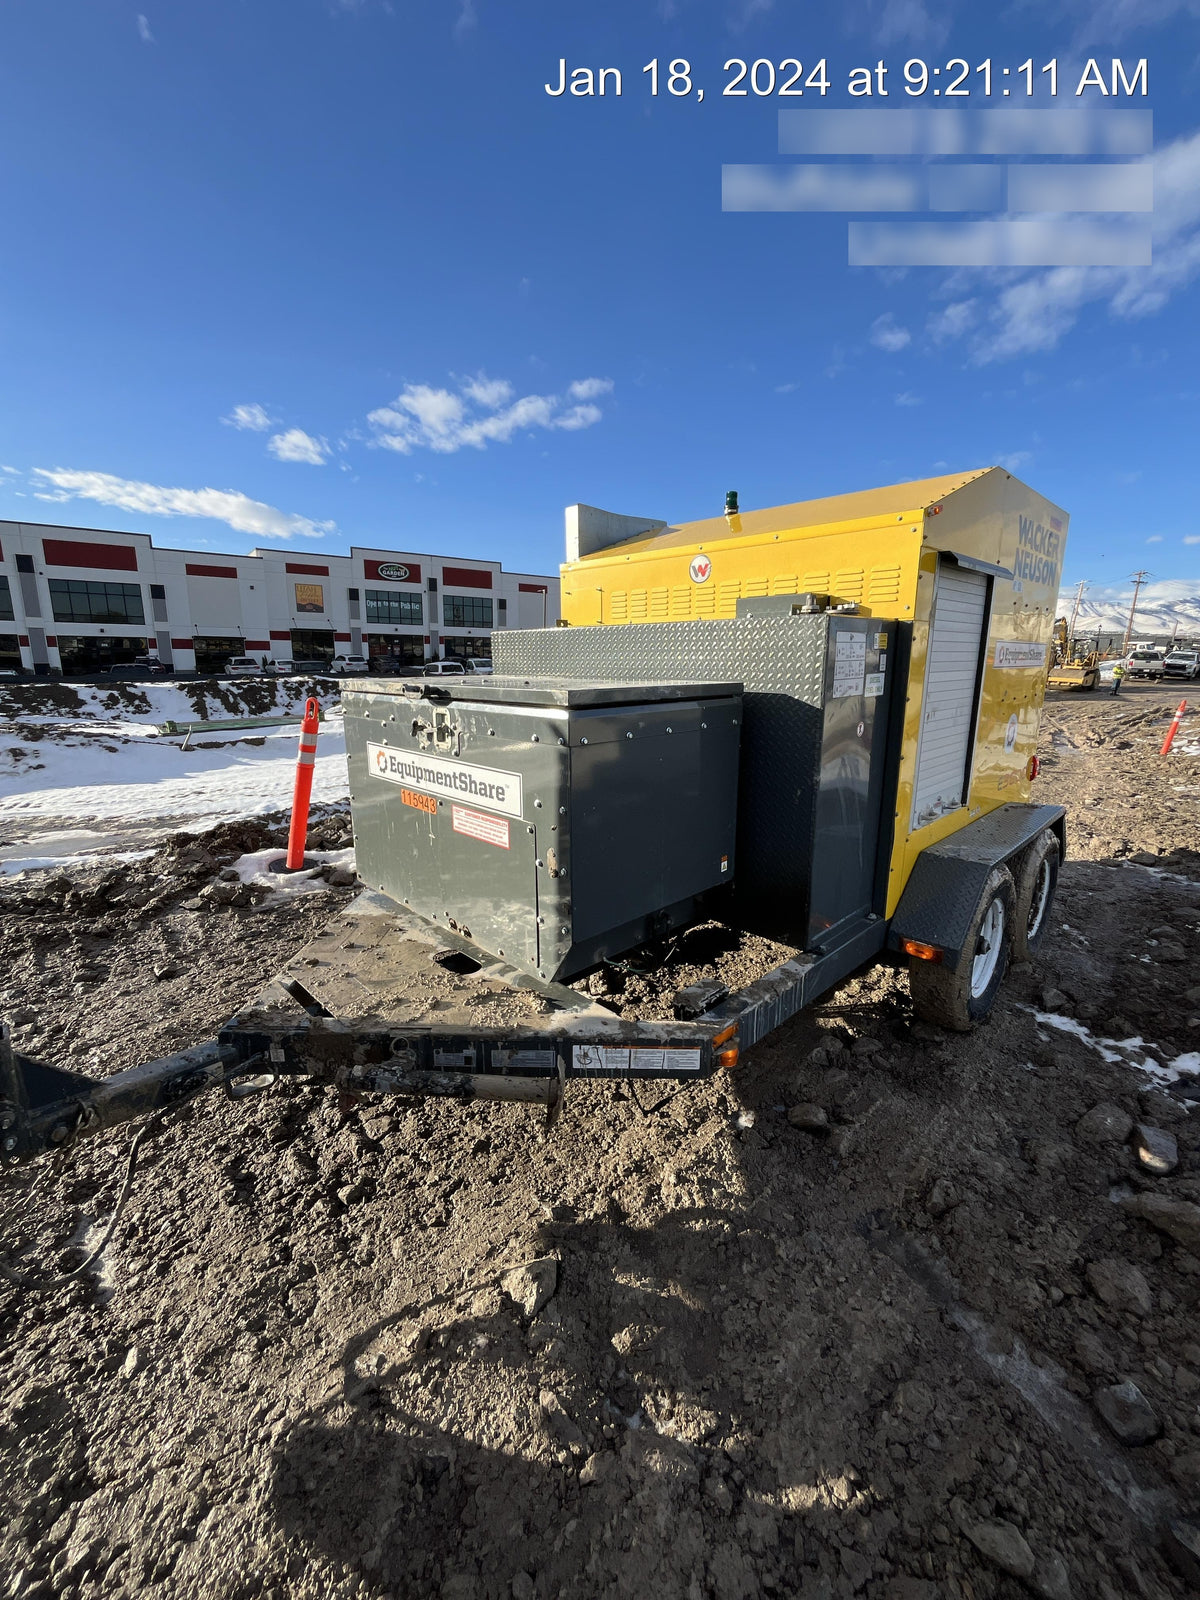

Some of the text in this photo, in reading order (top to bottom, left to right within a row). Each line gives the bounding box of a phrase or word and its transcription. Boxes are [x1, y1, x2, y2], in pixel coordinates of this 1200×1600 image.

[1018, 514, 1060, 560] WACKER
[382, 569, 406, 577] GARDEN
[1014, 547, 1058, 588] NEUSON
[366, 599, 382, 608] Open
[400, 601, 420, 610] Public
[389, 755, 506, 802] EquipmentShare
[401, 789, 437, 814] 115943
